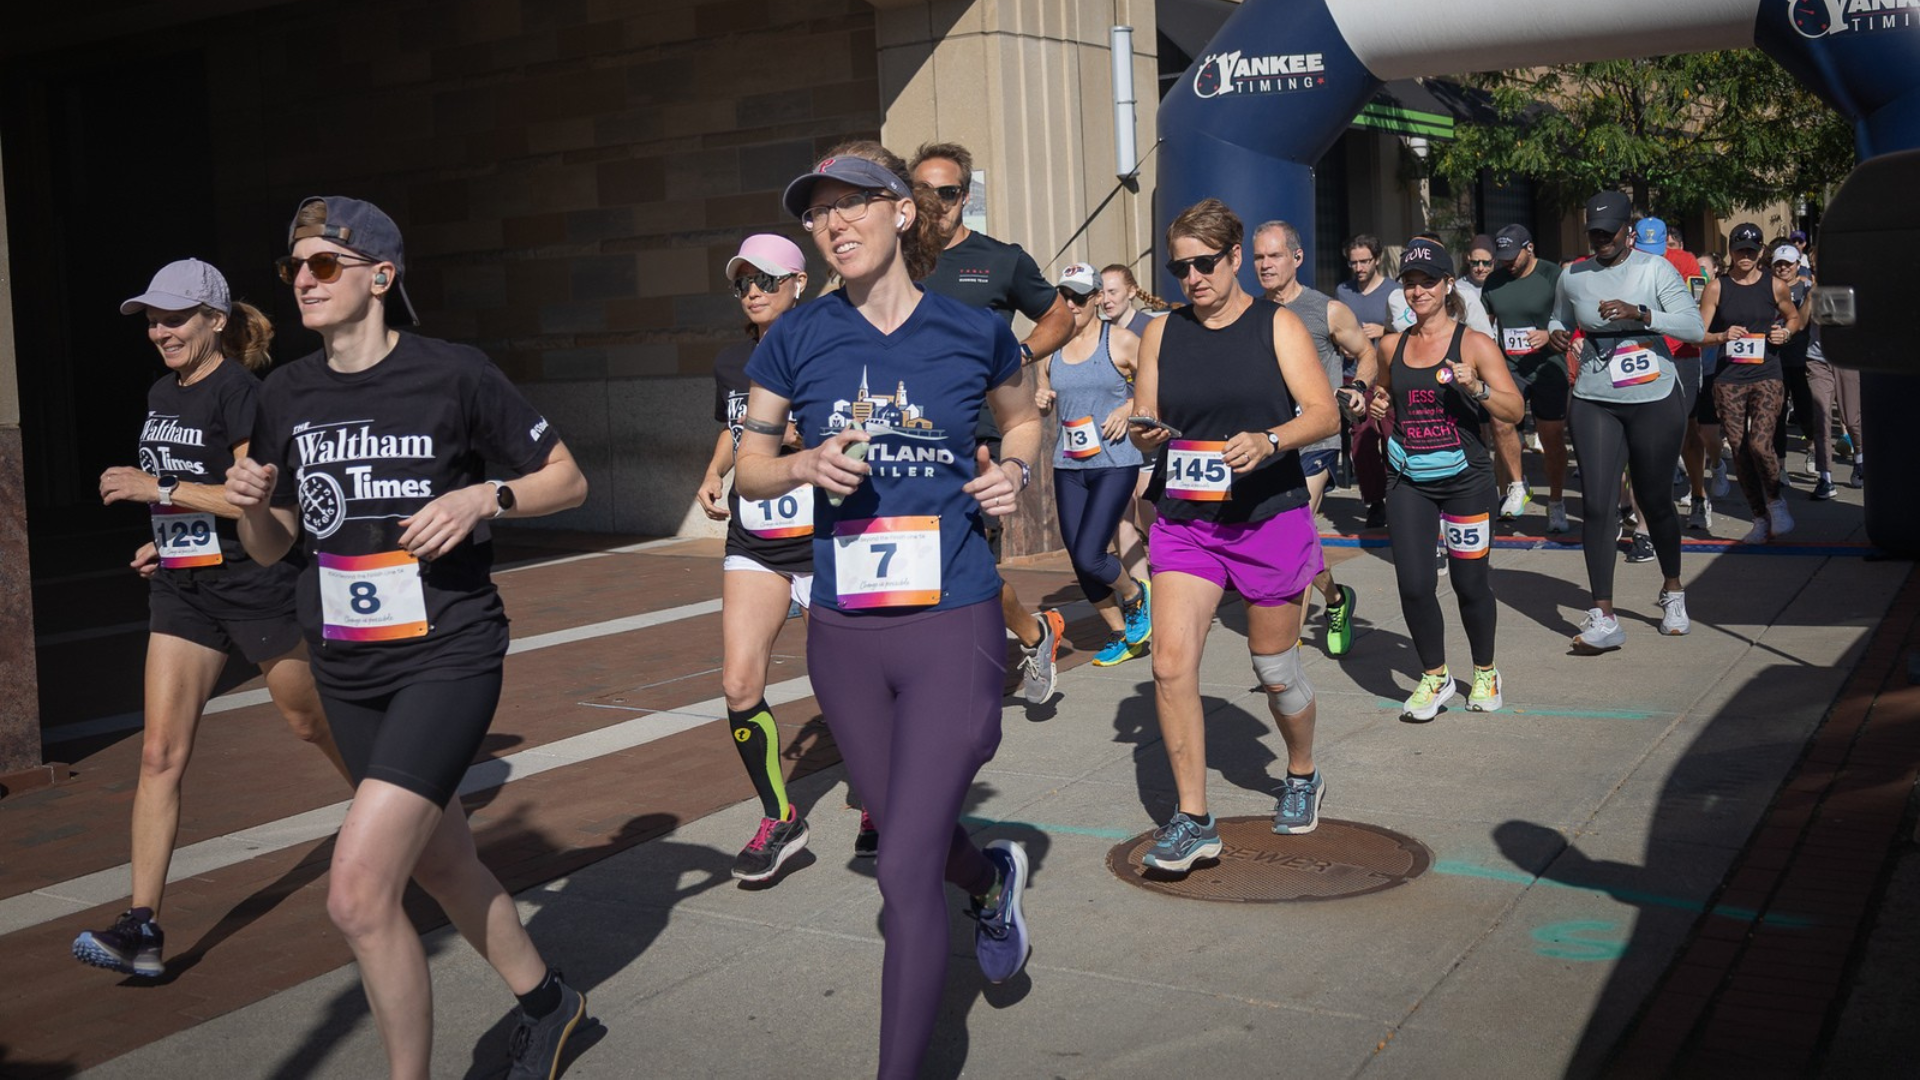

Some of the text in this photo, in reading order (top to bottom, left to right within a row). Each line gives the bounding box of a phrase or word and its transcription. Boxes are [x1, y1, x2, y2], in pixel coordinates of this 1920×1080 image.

[1851, 13, 1920, 31] TIMI
[1216, 50, 1325, 95] YANKEE
[1236, 76, 1313, 93] TIMING
[1734, 342, 1754, 354] 31
[1621, 354, 1650, 373] 65
[1408, 390, 1436, 407] JESS
[140, 418, 205, 446] Waltham
[1067, 431, 1088, 446] 13
[1407, 425, 1451, 439] REACH
[295, 425, 436, 466] Waltham
[867, 443, 955, 465] TLAND
[157, 446, 206, 475] Times
[1172, 457, 1226, 483] 145
[345, 465, 433, 499] Times
[758, 495, 798, 521] 10
[157, 520, 211, 548] 129
[1449, 527, 1480, 546] 35
[870, 542, 897, 578] 7
[349, 581, 381, 615] 8
